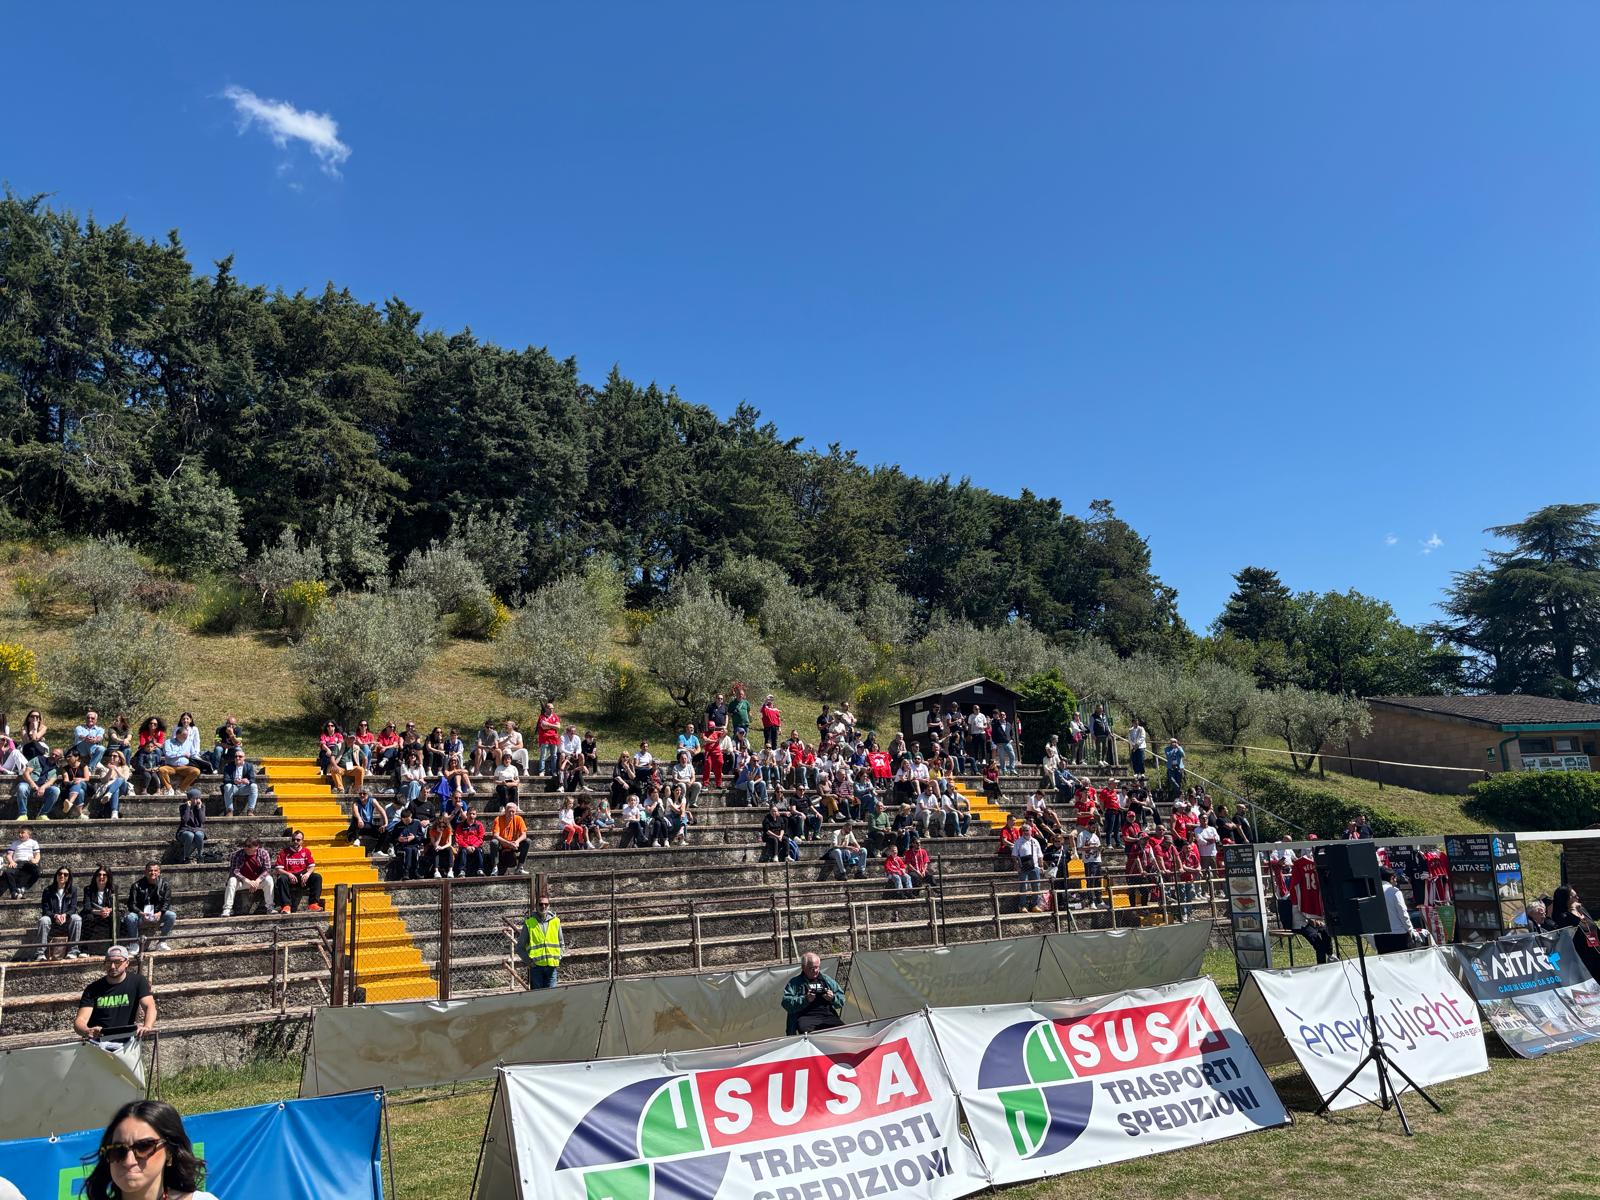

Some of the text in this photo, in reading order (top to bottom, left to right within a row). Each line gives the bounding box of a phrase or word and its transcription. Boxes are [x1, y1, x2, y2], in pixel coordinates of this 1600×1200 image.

[1068, 1005, 1219, 1068] SUSA
[713, 1051, 919, 1135] SUSA
[1100, 1057, 1241, 1105] TRASPORTI
[1117, 1086, 1260, 1137] SPEDIZIONI
[741, 1112, 941, 1181] TRASPORTI
